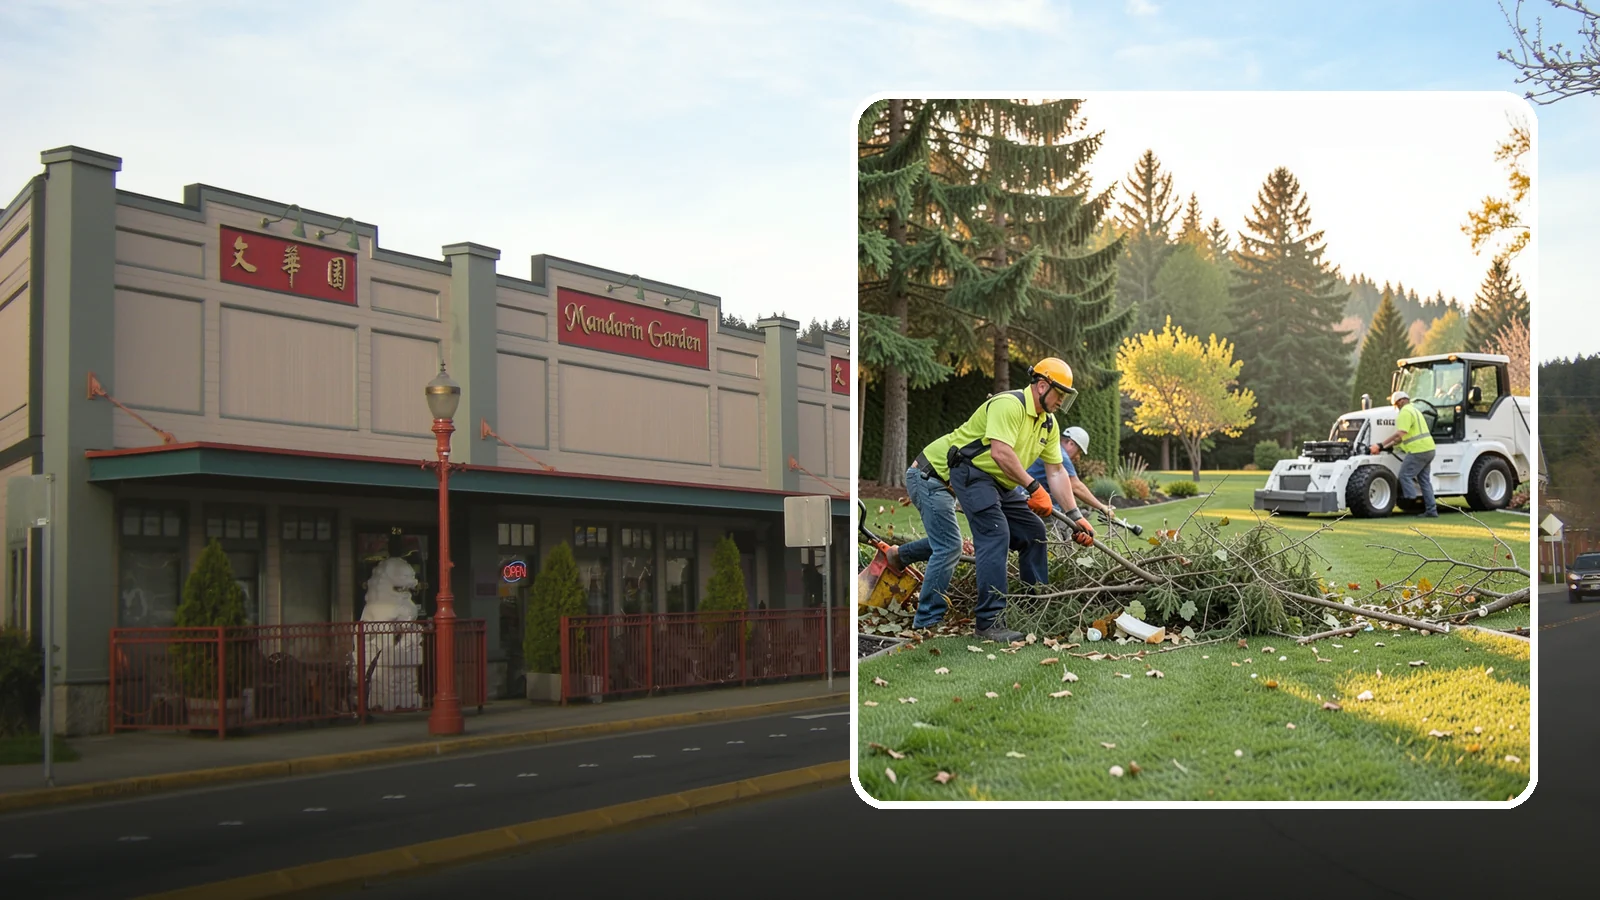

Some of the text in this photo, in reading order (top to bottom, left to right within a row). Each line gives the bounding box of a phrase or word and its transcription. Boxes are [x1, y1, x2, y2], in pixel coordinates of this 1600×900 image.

[564, 302, 701, 352] Mandarin Garden
[503, 565, 527, 578] OPEN
